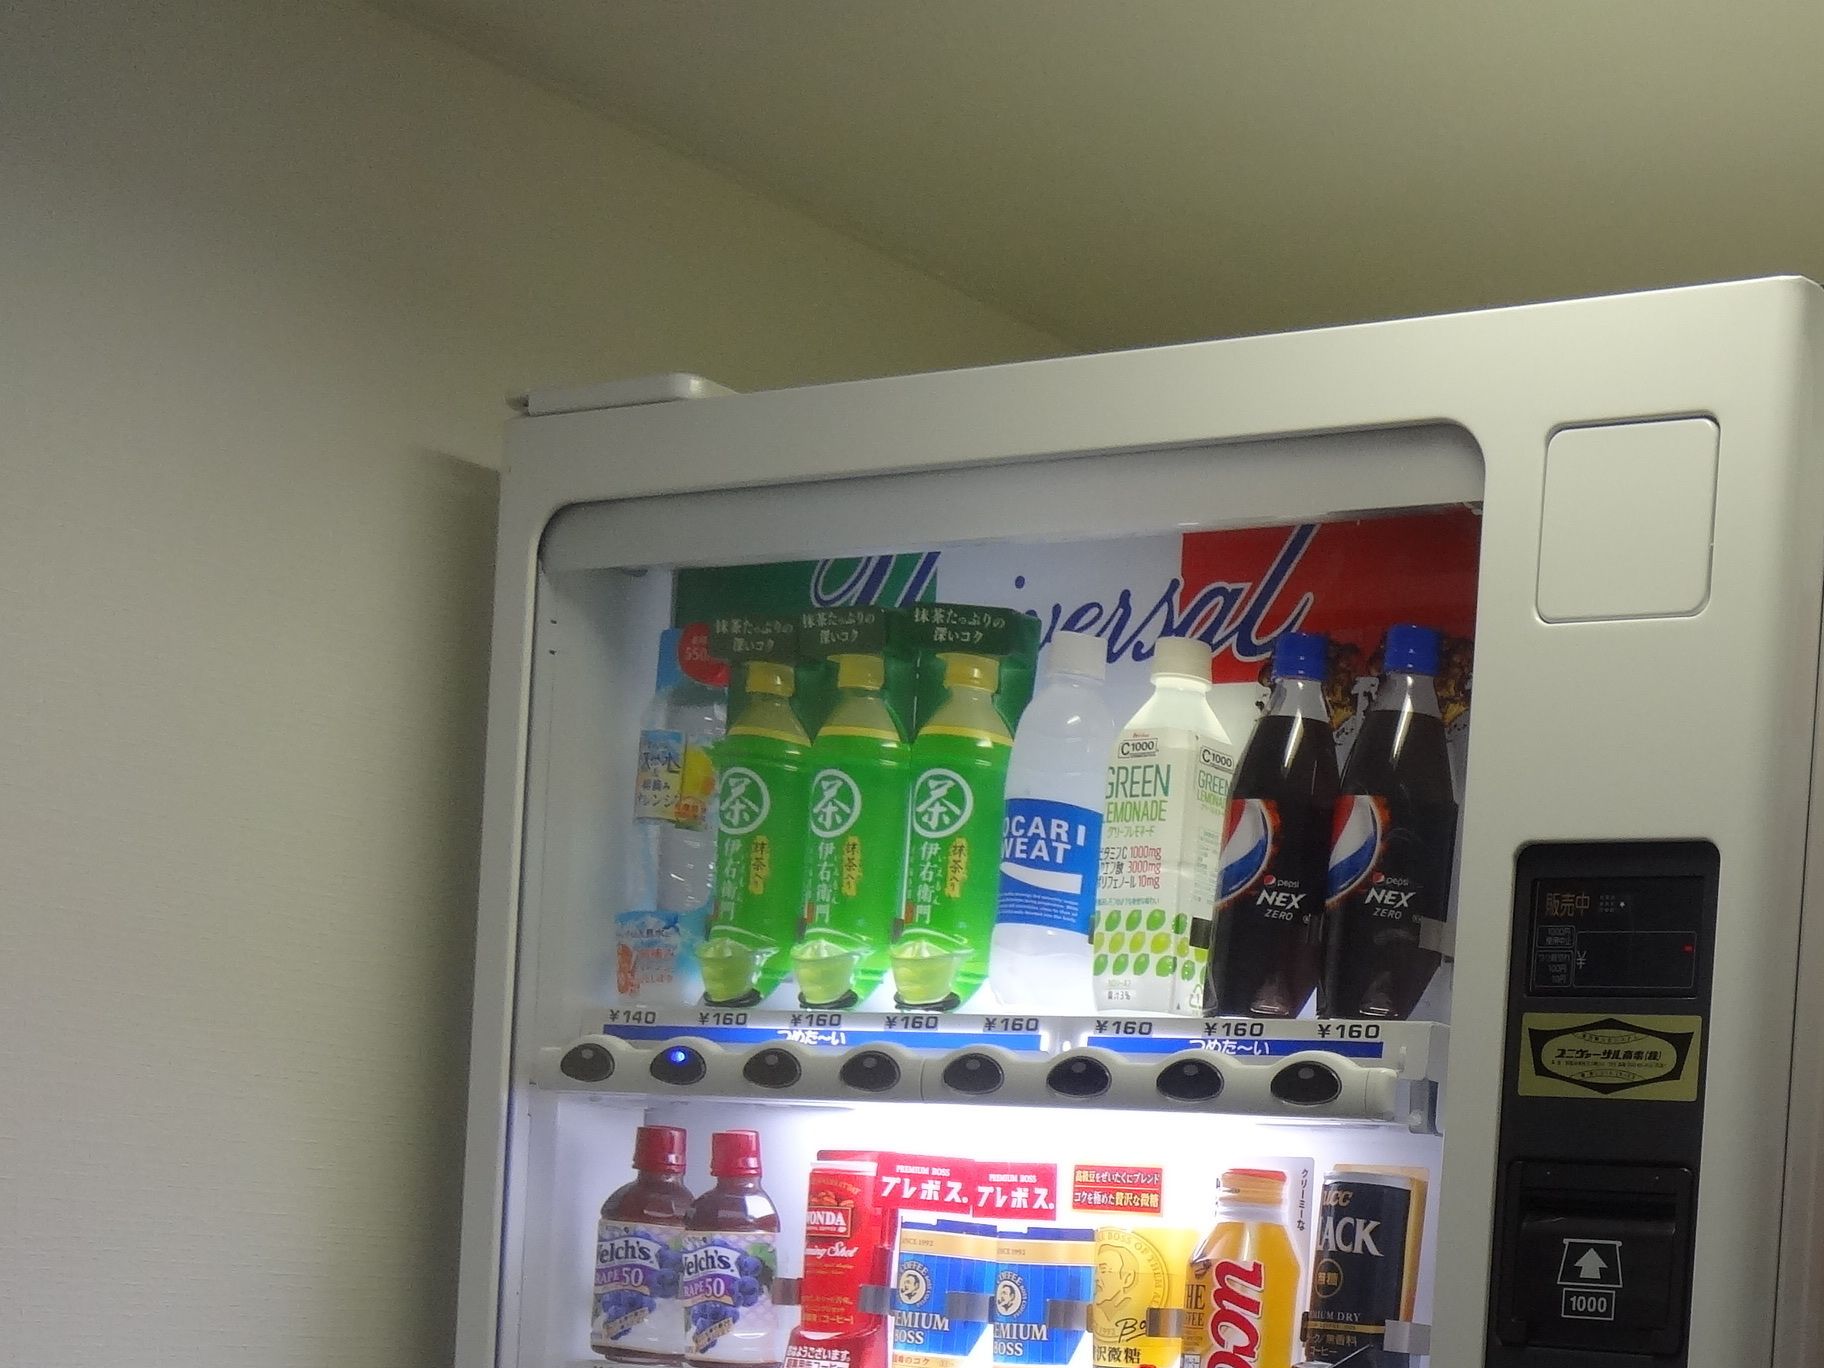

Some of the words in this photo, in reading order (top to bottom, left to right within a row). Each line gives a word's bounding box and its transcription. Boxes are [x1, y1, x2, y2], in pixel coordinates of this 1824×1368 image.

[914, 606, 1006, 630] 抹茶たっぷりの
[933, 626, 984, 644] 深いコク
[1120, 739, 1156, 757] C1000
[1201, 749, 1233, 768] C1000
[1105, 763, 1171, 800] GREEN
[719, 777, 759, 828] 茶
[812, 778, 852, 830] 茶
[914, 778, 962, 829] 茶
[1129, 847, 1162, 861] 1000mg
[1127, 861, 1162, 875] 3000mg
[1138, 876, 1161, 889] 10mg
[1277, 879, 1300, 889] pepsi
[1386, 876, 1409, 887] pepsi
[1256, 891, 1306, 910] NEX
[1365, 888, 1416, 909] NEX
[1545, 891, 1591, 918] 販売中
[1264, 908, 1294, 922] ZERO
[1372, 907, 1402, 921] ZERO
[608, 1009, 657, 1025] ¥140
[699, 1012, 748, 1026] ¥160
[791, 1013, 842, 1027] ¥160
[885, 1014, 939, 1030] ¥160
[983, 1017, 1039, 1032] ¥160
[1095, 1019, 1153, 1036] ¥160
[1204, 1022, 1264, 1037] ¥160
[1317, 1023, 1380, 1039] ¥160
[896, 1165, 929, 1175] PREMIUM
[931, 1167, 950, 1177] BOSS
[621, 1267, 644, 1288] 50
[705, 1277, 726, 1298] 50
[1569, 1295, 1608, 1313] 1000
